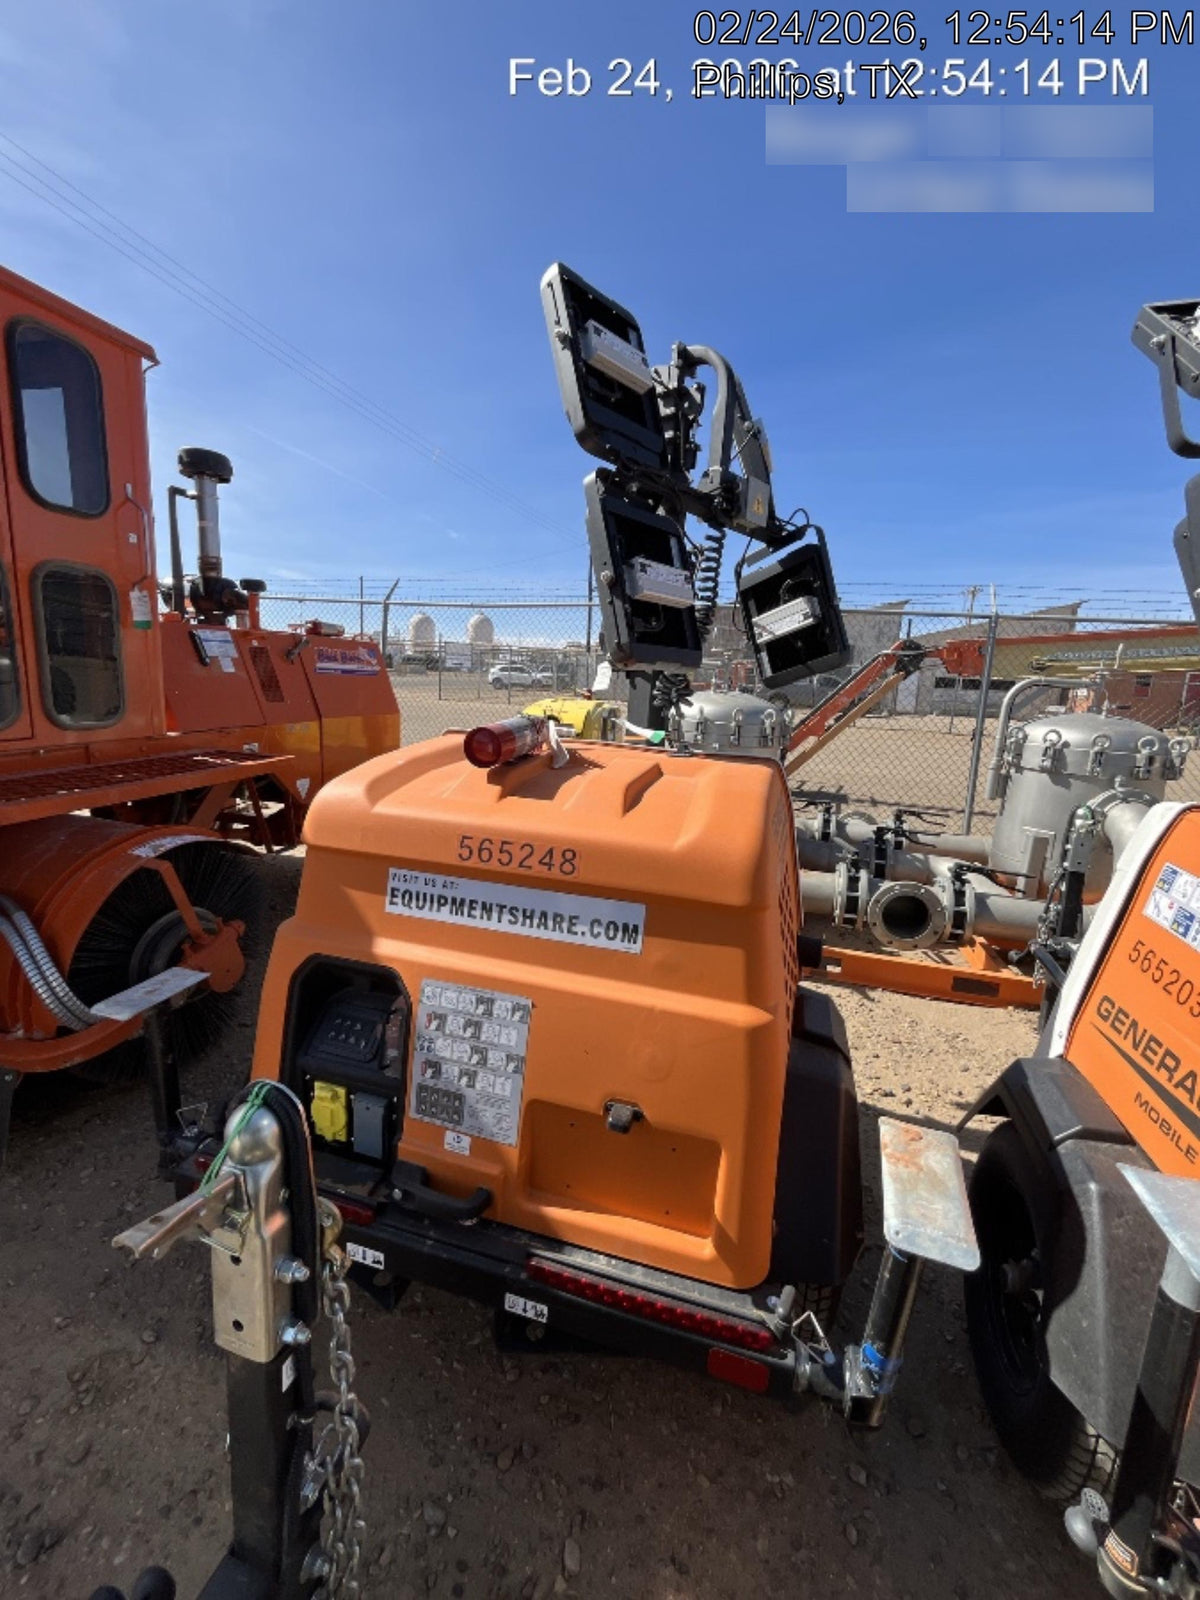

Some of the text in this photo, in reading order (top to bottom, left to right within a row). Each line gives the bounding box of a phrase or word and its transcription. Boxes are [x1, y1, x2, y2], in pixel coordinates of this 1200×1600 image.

[392, 872, 459, 890] VISIT US AT:
[457, 835, 578, 876] 565248
[389, 886, 640, 945] EQUIPMENTSHARE.COM
[1096, 995, 1200, 1111] GENERA
[1134, 1091, 1199, 1165] MOBILE
